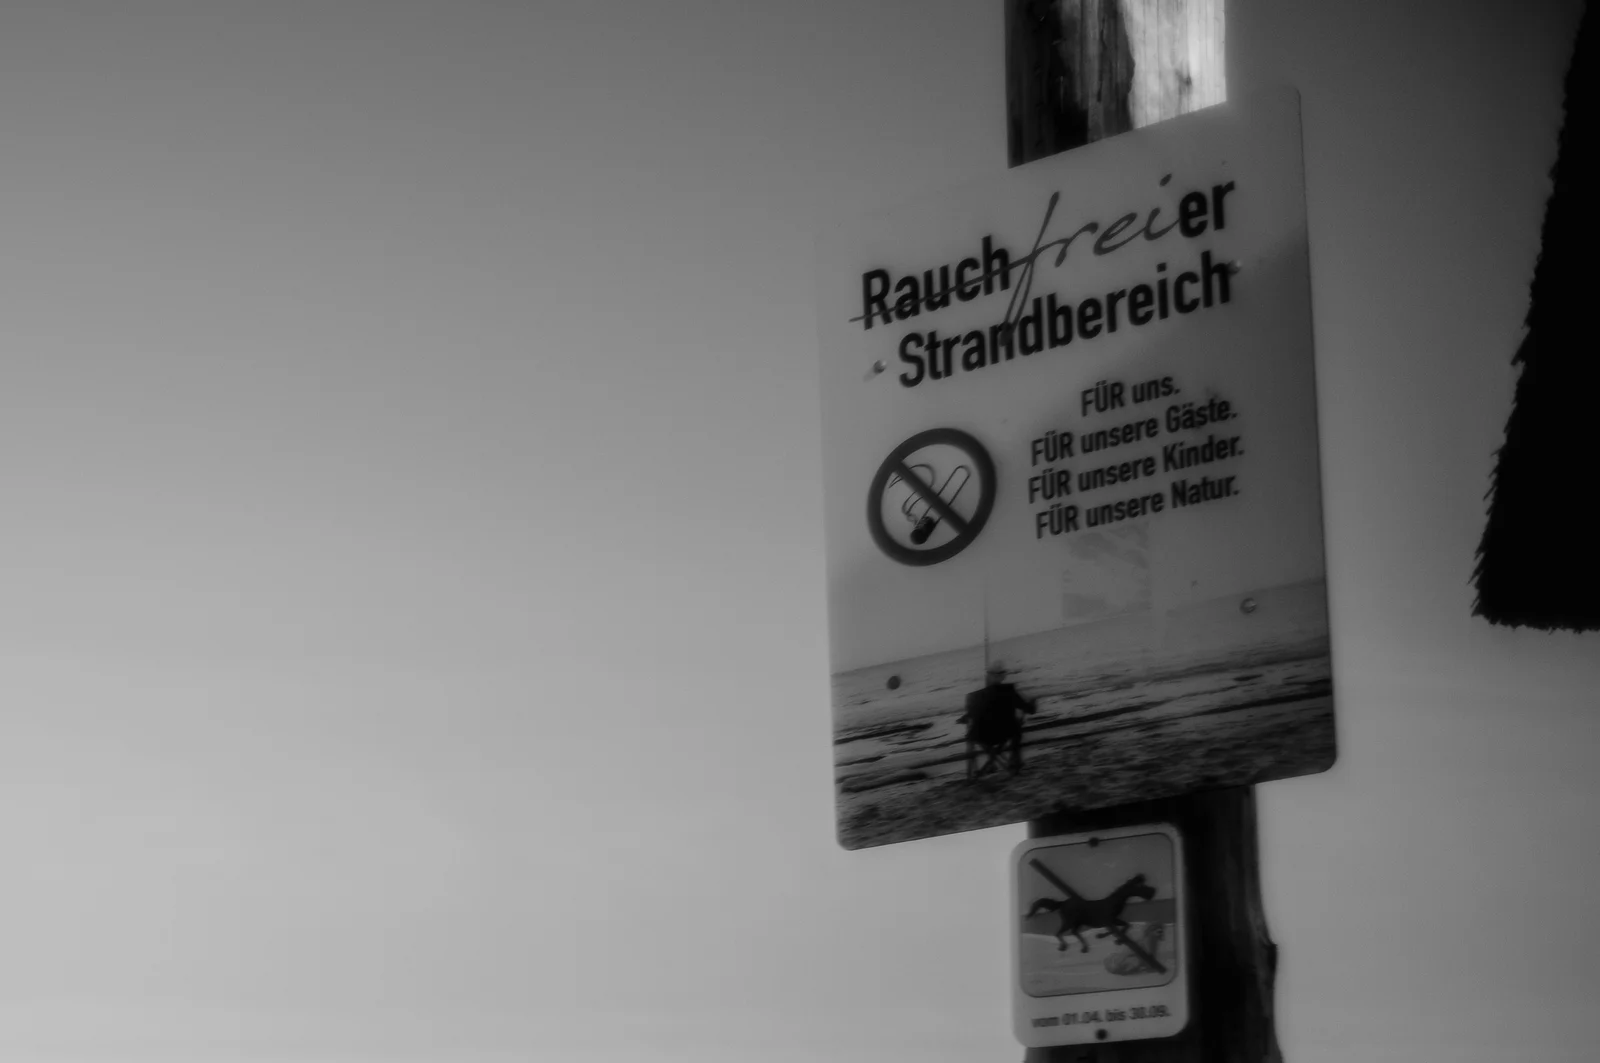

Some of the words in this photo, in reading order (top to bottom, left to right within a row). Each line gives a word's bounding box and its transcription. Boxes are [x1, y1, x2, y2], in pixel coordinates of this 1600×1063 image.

[849, 172, 1235, 338] Rauchfreier
[900, 250, 1233, 388] Strandbereich
[1081, 380, 1125, 418] FÜR
[1131, 375, 1181, 404] uns.
[1030, 431, 1073, 467] FÜR
[1080, 417, 1158, 454] unsere
[1165, 398, 1238, 434] Gäste.
[1027, 468, 1071, 504] FÜR
[1077, 454, 1156, 492] unsere
[1162, 433, 1245, 473] Kinder.
[1035, 504, 1079, 540] FÜR
[1086, 491, 1165, 528] unsere
[1171, 475, 1241, 509] Natur.
[1105, 1008, 1126, 1022] bis
